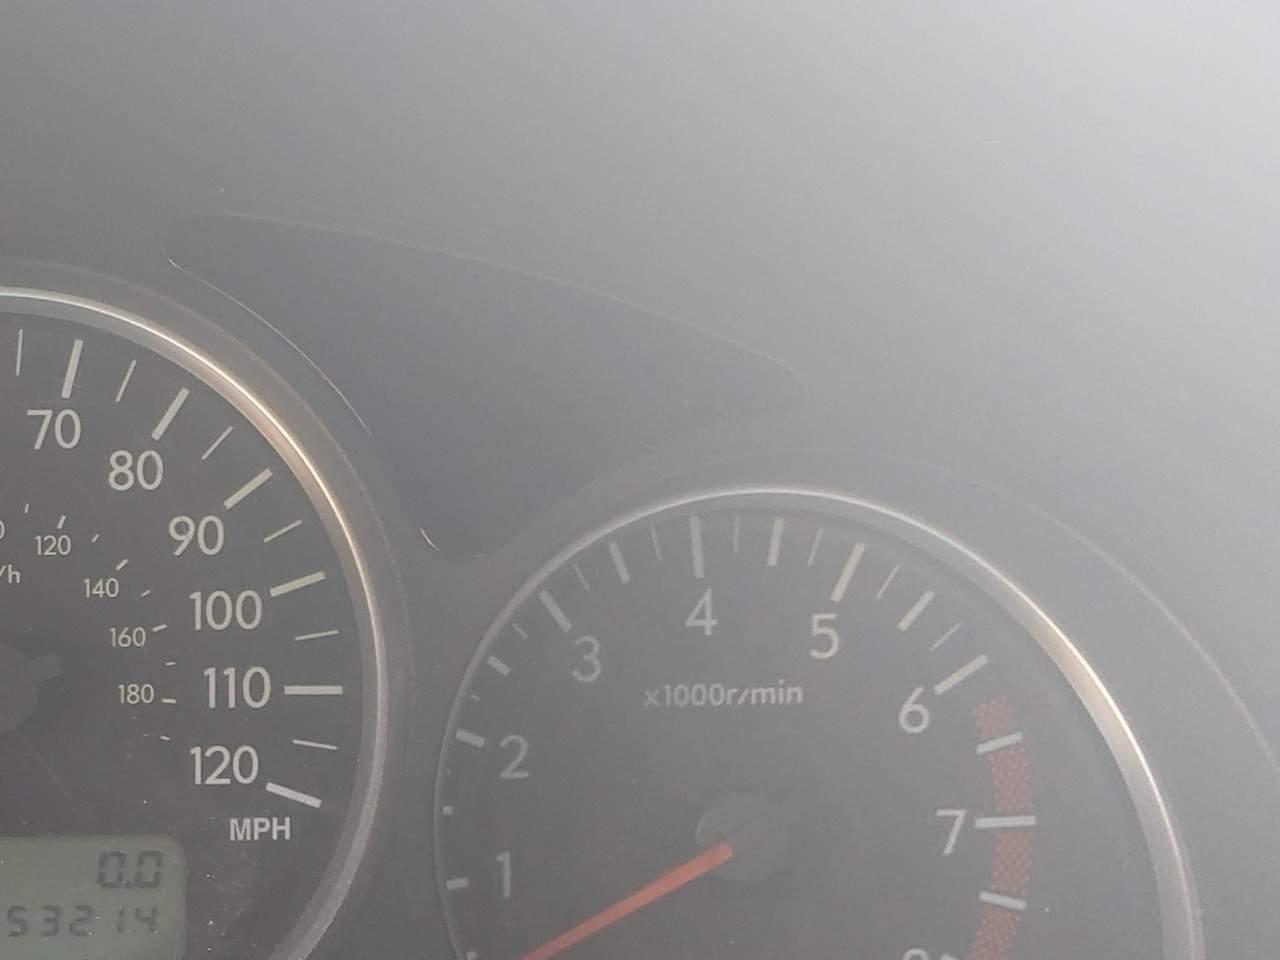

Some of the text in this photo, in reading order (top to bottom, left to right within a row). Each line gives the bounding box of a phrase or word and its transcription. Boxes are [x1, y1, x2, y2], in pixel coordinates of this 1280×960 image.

[27, 411, 82, 449] 70
[108, 451, 164, 490] 80
[35, 535, 71, 557] 120
[168, 516, 225, 556] 90
[84, 578, 119, 599] 140
[190, 591, 263, 629] 100
[684, 589, 718, 637] 4
[110, 628, 146, 649] 160
[810, 613, 840, 660] 5
[573, 637, 603, 682] 3
[119, 685, 154, 706] 180
[204, 667, 271, 709] 110
[899, 687, 930, 734] 6
[190, 745, 260, 786] 120
[499, 736, 530, 780] 2
[229, 817, 292, 842] MPH
[936, 808, 968, 855] 7
[98, 851, 163, 889] 0.0
[496, 851, 512, 897] 1
